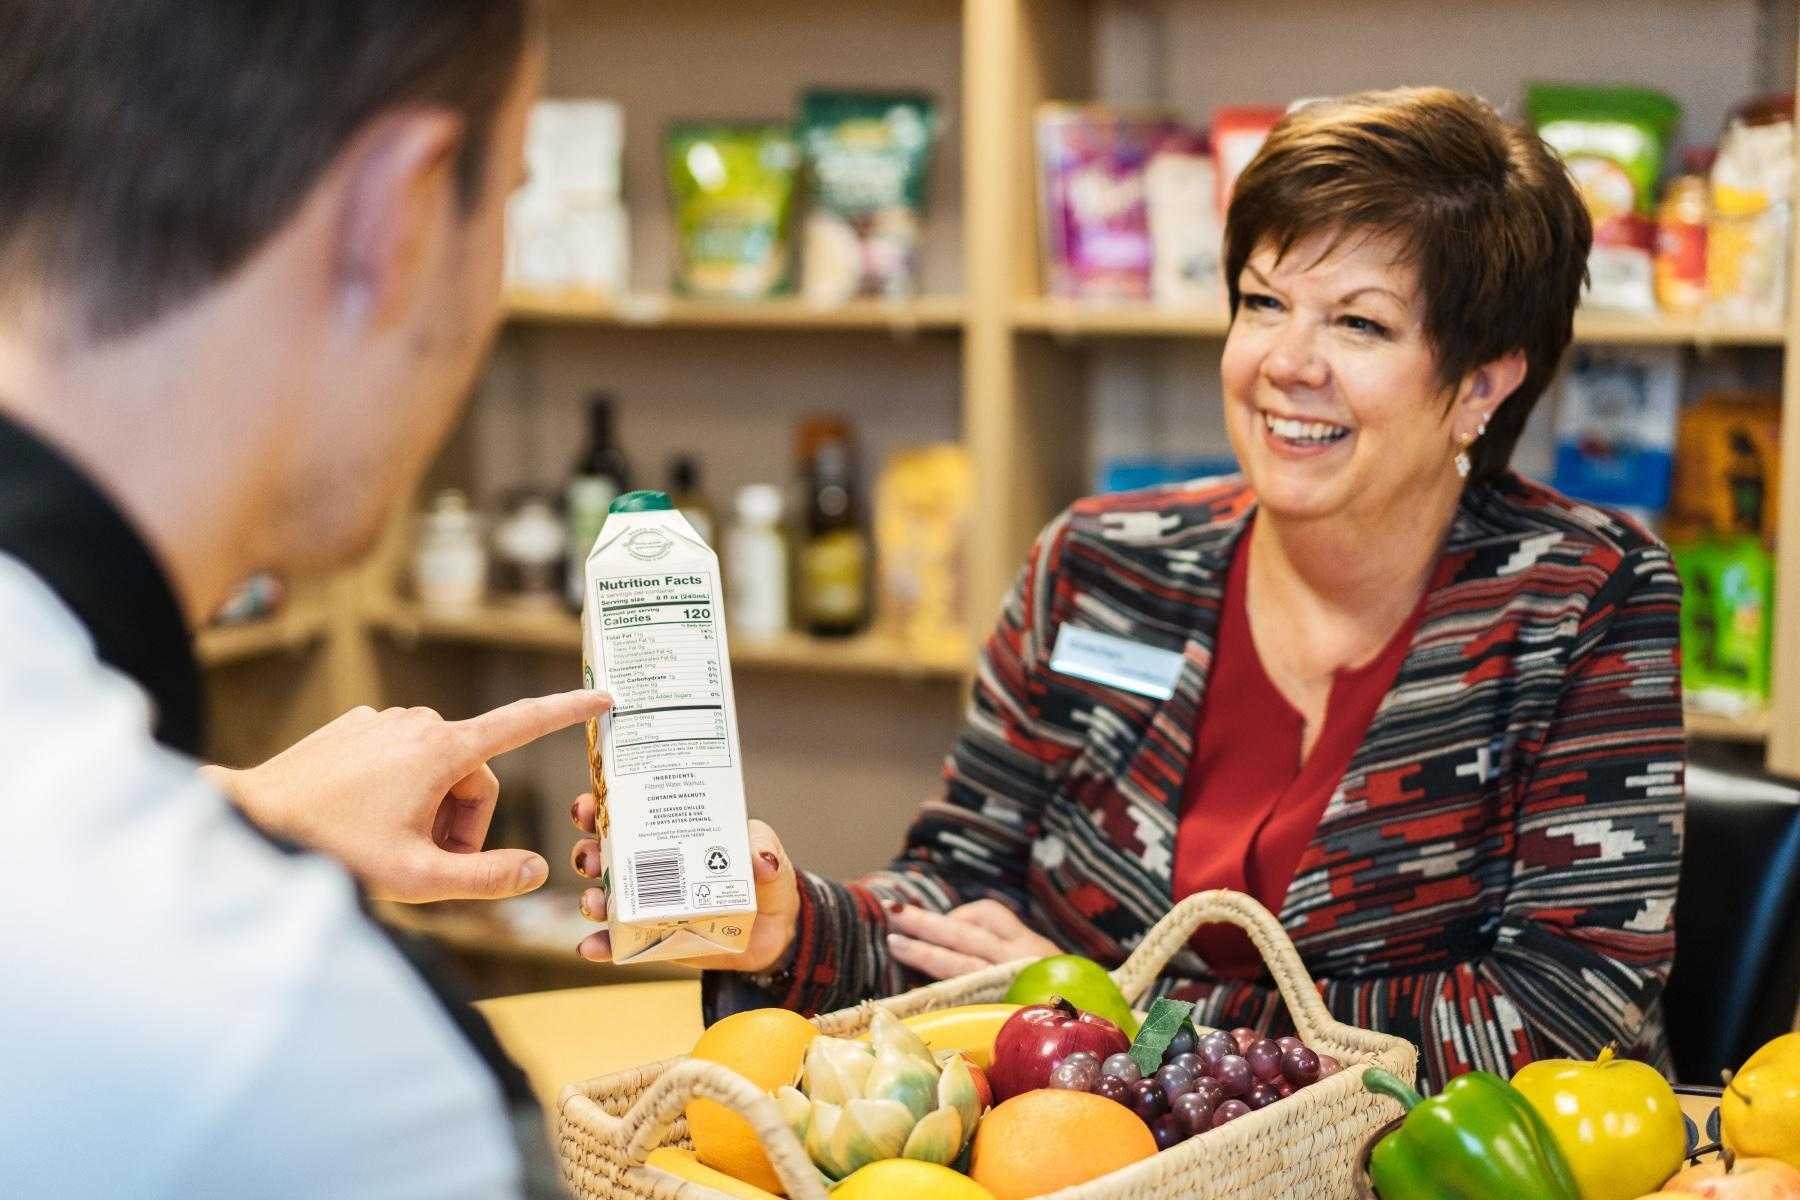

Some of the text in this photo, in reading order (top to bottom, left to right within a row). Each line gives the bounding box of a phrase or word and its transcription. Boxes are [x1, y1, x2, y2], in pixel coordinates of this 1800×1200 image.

[599, 575, 702, 591] Nutrition Facts
[602, 610, 626, 618] Amount
[604, 608, 711, 626] Calories 120
[626, 674, 667, 684] Carbohydrate
